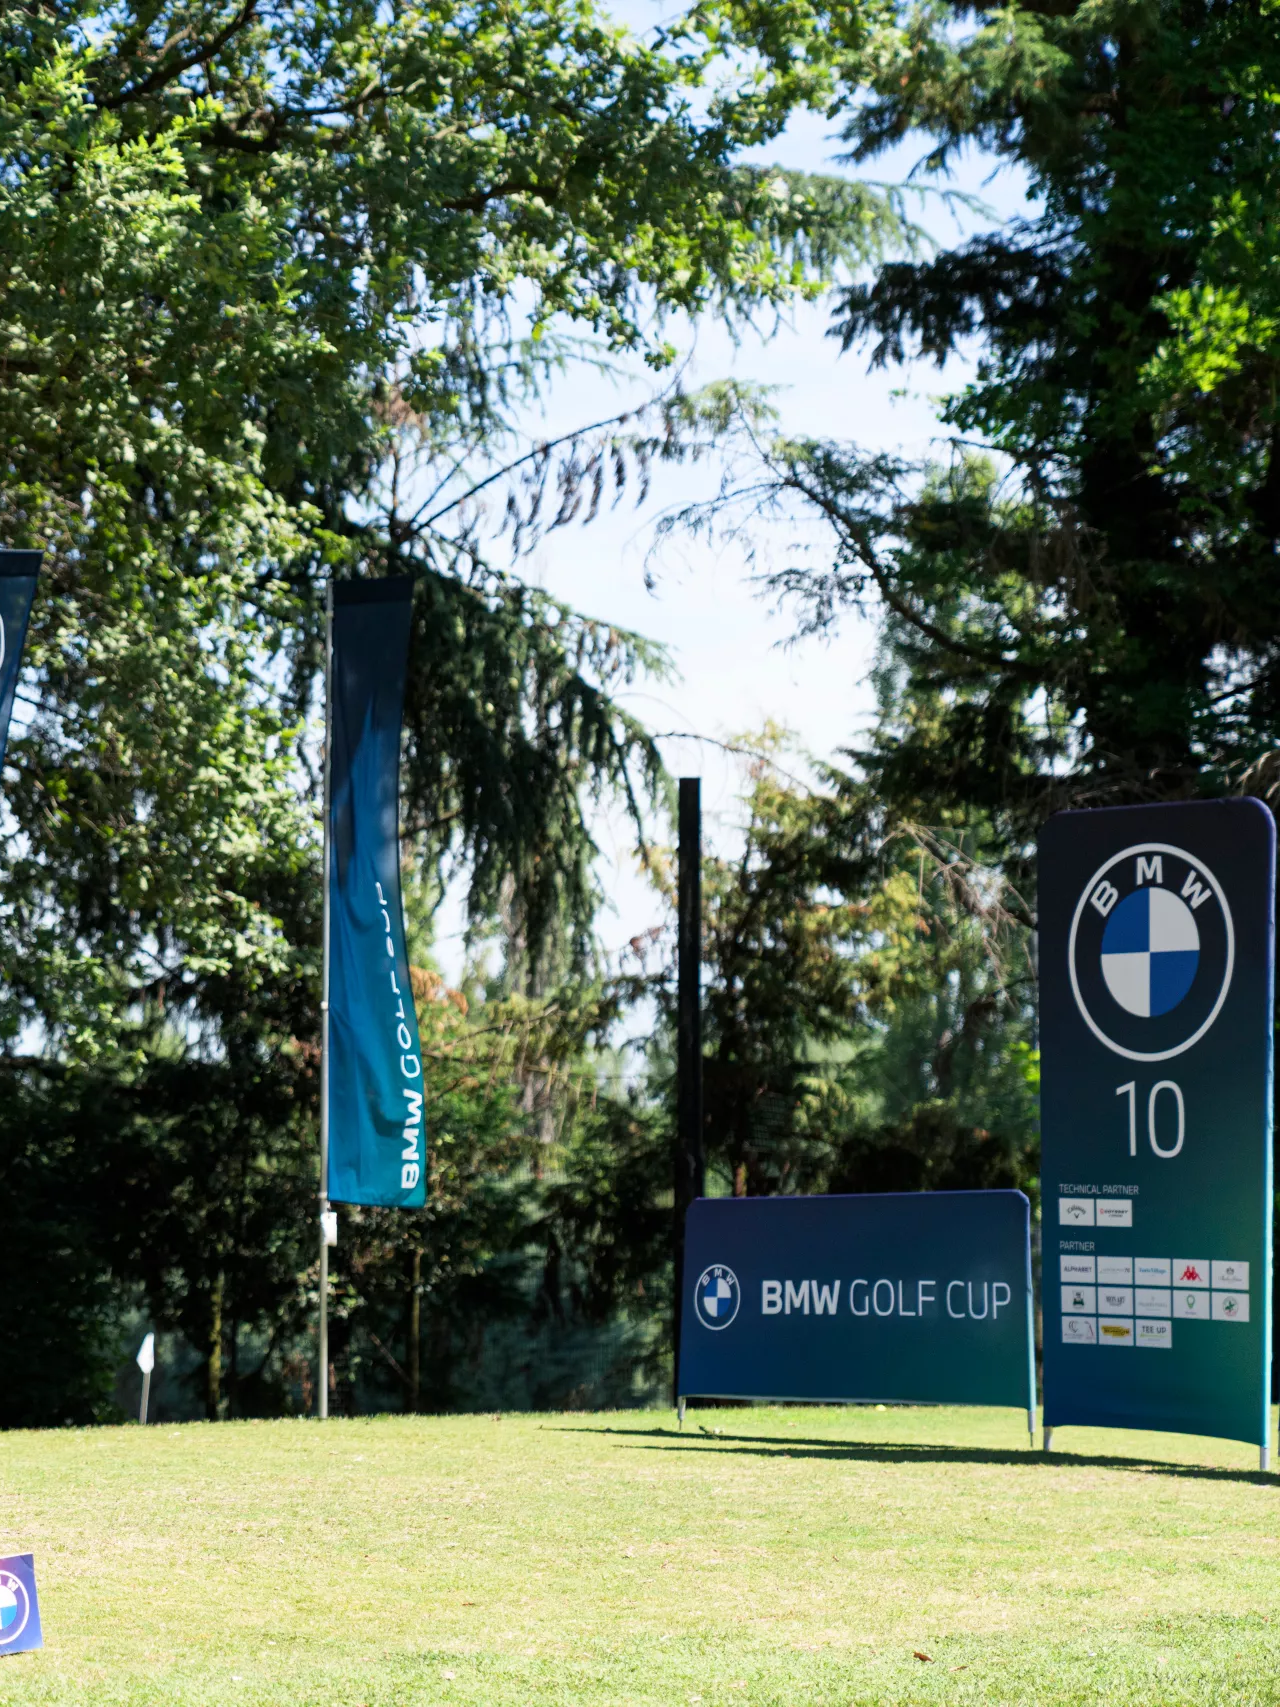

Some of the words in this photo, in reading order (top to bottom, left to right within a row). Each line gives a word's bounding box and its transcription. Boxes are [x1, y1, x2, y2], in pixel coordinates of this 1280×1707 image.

[1090, 855, 1213, 917] BMW
[1116, 1080, 1185, 1158] 10
[401, 1089, 423, 1190] BMW
[1059, 1184, 1101, 1194] TECHNICAL
[1103, 1185, 1139, 1195] PARTNER
[1060, 1241, 1095, 1251] PARTNER
[701, 1268, 735, 1286] BMW
[761, 1280, 841, 1315] BMW
[850, 1279, 936, 1317] GOLF
[946, 1280, 1012, 1320] CUP
[1142, 1325, 1154, 1334] TEE
[1156, 1326, 1167, 1334] UP
